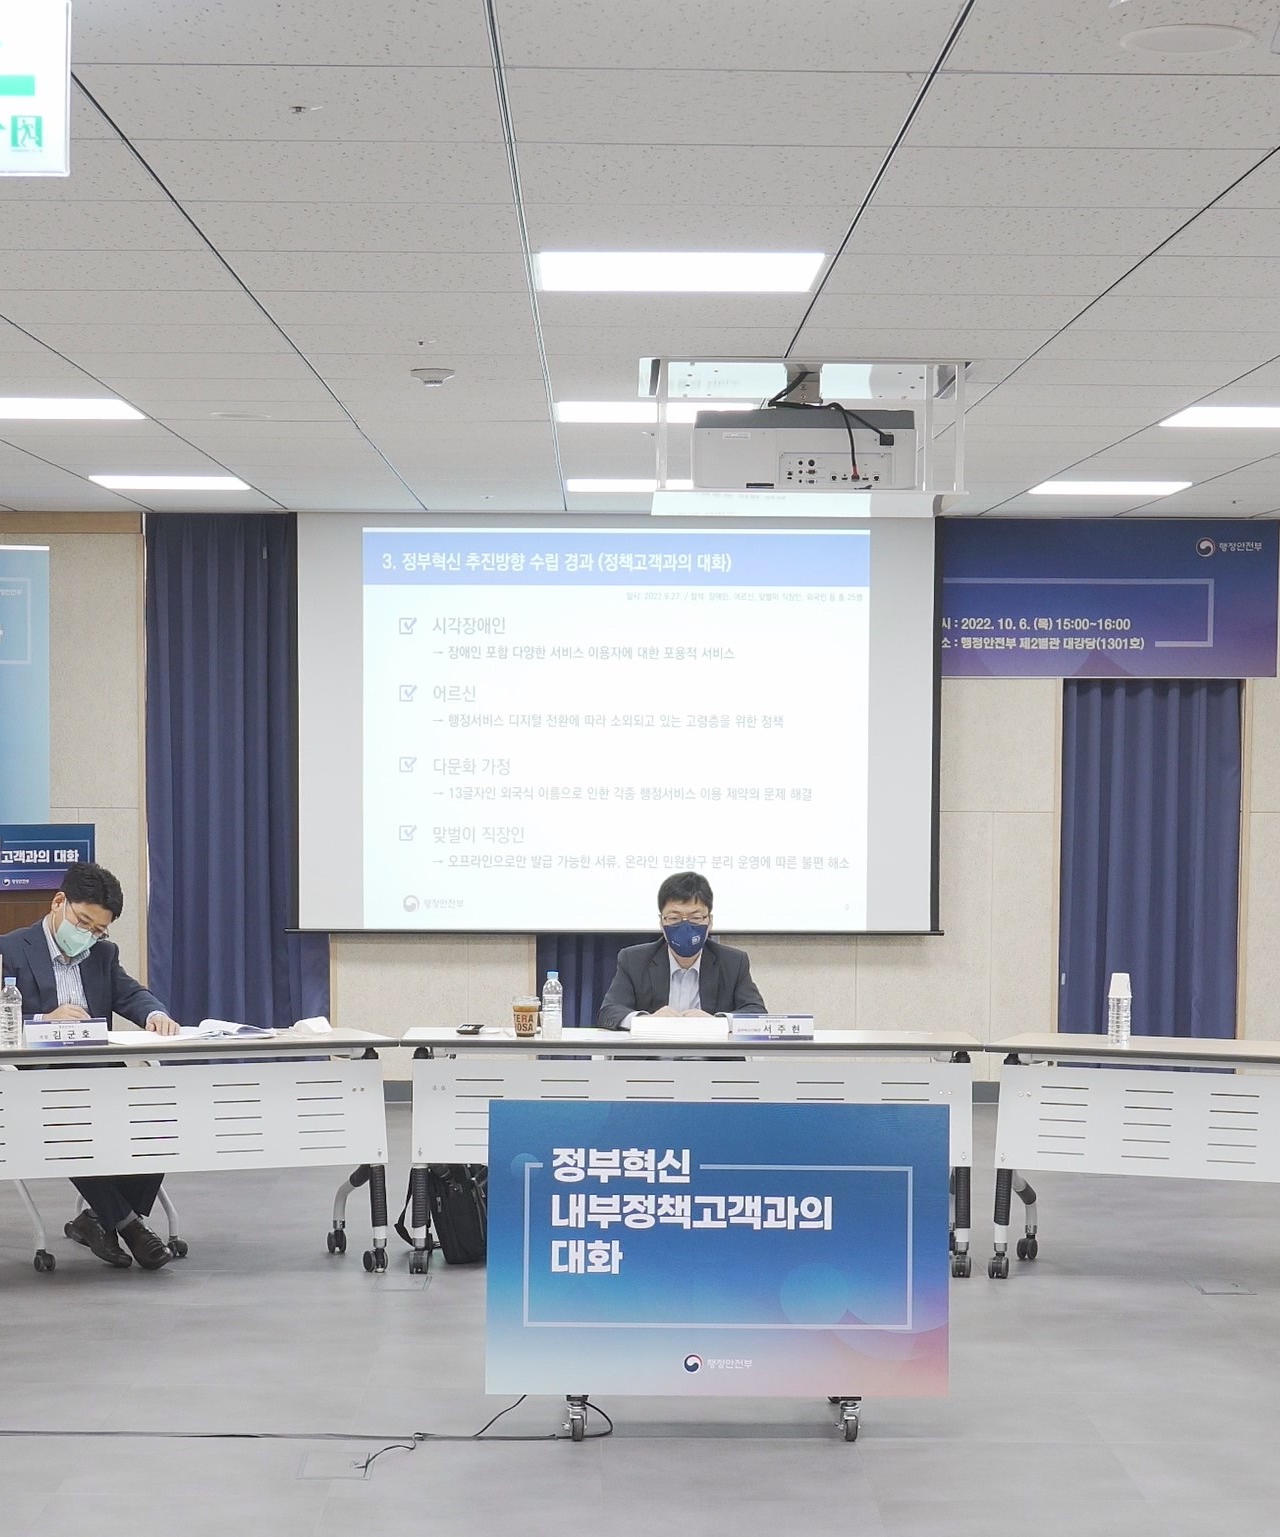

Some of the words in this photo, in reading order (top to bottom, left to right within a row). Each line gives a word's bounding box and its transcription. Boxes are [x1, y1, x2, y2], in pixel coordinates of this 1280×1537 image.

[1218, 541, 1263, 552] 행정안전부
[382, 553, 396, 570] 3.
[402, 552, 461, 571] 정부혁신
[466, 552, 525, 572] 추진방향
[529, 553, 558, 571] 수립
[565, 553, 594, 572] 경과
[598, 553, 691, 573] (정책고객과의
[698, 554, 731, 573] 대화)
[433, 616, 506, 636] 시각장애인
[961, 618, 994, 630] 2022.
[998, 618, 1016, 630] 10.
[1019, 618, 1030, 630] 6.
[1034, 618, 1053, 631] (목)
[1056, 618, 1131, 630] 15:00~16:00
[961, 637, 1016, 649] 행정안전부
[1019, 637, 1060, 650] 제2별관
[448, 645, 481, 660] 장애인
[486, 645, 508, 660] 포함
[513, 645, 546, 660] 다양한
[550, 645, 584, 660] 서비스
[588, 646, 632, 660] 이용자에
[638, 646, 659, 660] 대한
[664, 646, 696, 661] 포용적
[702, 646, 735, 661] 서비스
[433, 684, 476, 703] 어르신
[448, 713, 504, 728] 행정서비스
[509, 713, 541, 728] 디지털
[547, 713, 579, 728] 전환에
[585, 714, 606, 728] 따라
[611, 714, 655, 728] 소외되고
[660, 714, 681, 729] 있는
[686, 714, 730, 729] 고령층을
[736, 714, 757, 729] 위한
[762, 714, 784, 729] 정책
[433, 757, 476, 776] 다문화
[482, 758, 511, 776] 가정
[449, 786, 495, 800] 13글자인
[501, 786, 534, 801] 외국식
[538, 786, 582, 801] 이름으로
[587, 786, 609, 801] 인한
[614, 786, 636, 801] 각종
[640, 787, 696, 801] 행정서비스
[700, 787, 722, 801] 이용
[727, 787, 759, 802] 제약의
[764, 787, 785, 802] 문제
[790, 787, 812, 802] 해결
[433, 825, 476, 844] 맞벌이
[482, 826, 525, 845] 직장인
[54, 850, 79, 863] 대화
[448, 854, 526, 869] 오프라인으로만
[531, 854, 553, 869] 발급
[558, 855, 590, 869] 가능한
[625, 855, 657, 869] 온라인
[663, 855, 706, 870] 민원창구
[711, 855, 733, 870] 분리
[738, 855, 770, 870] 운영에
[776, 856, 797, 870] 따른
[802, 856, 824, 871] 불편
[828, 856, 850, 871] 해소
[551, 1148, 691, 1183] 정부혁신
[550, 1194, 833, 1231] 내부정책고객과의
[550, 1240, 623, 1275] 대화
